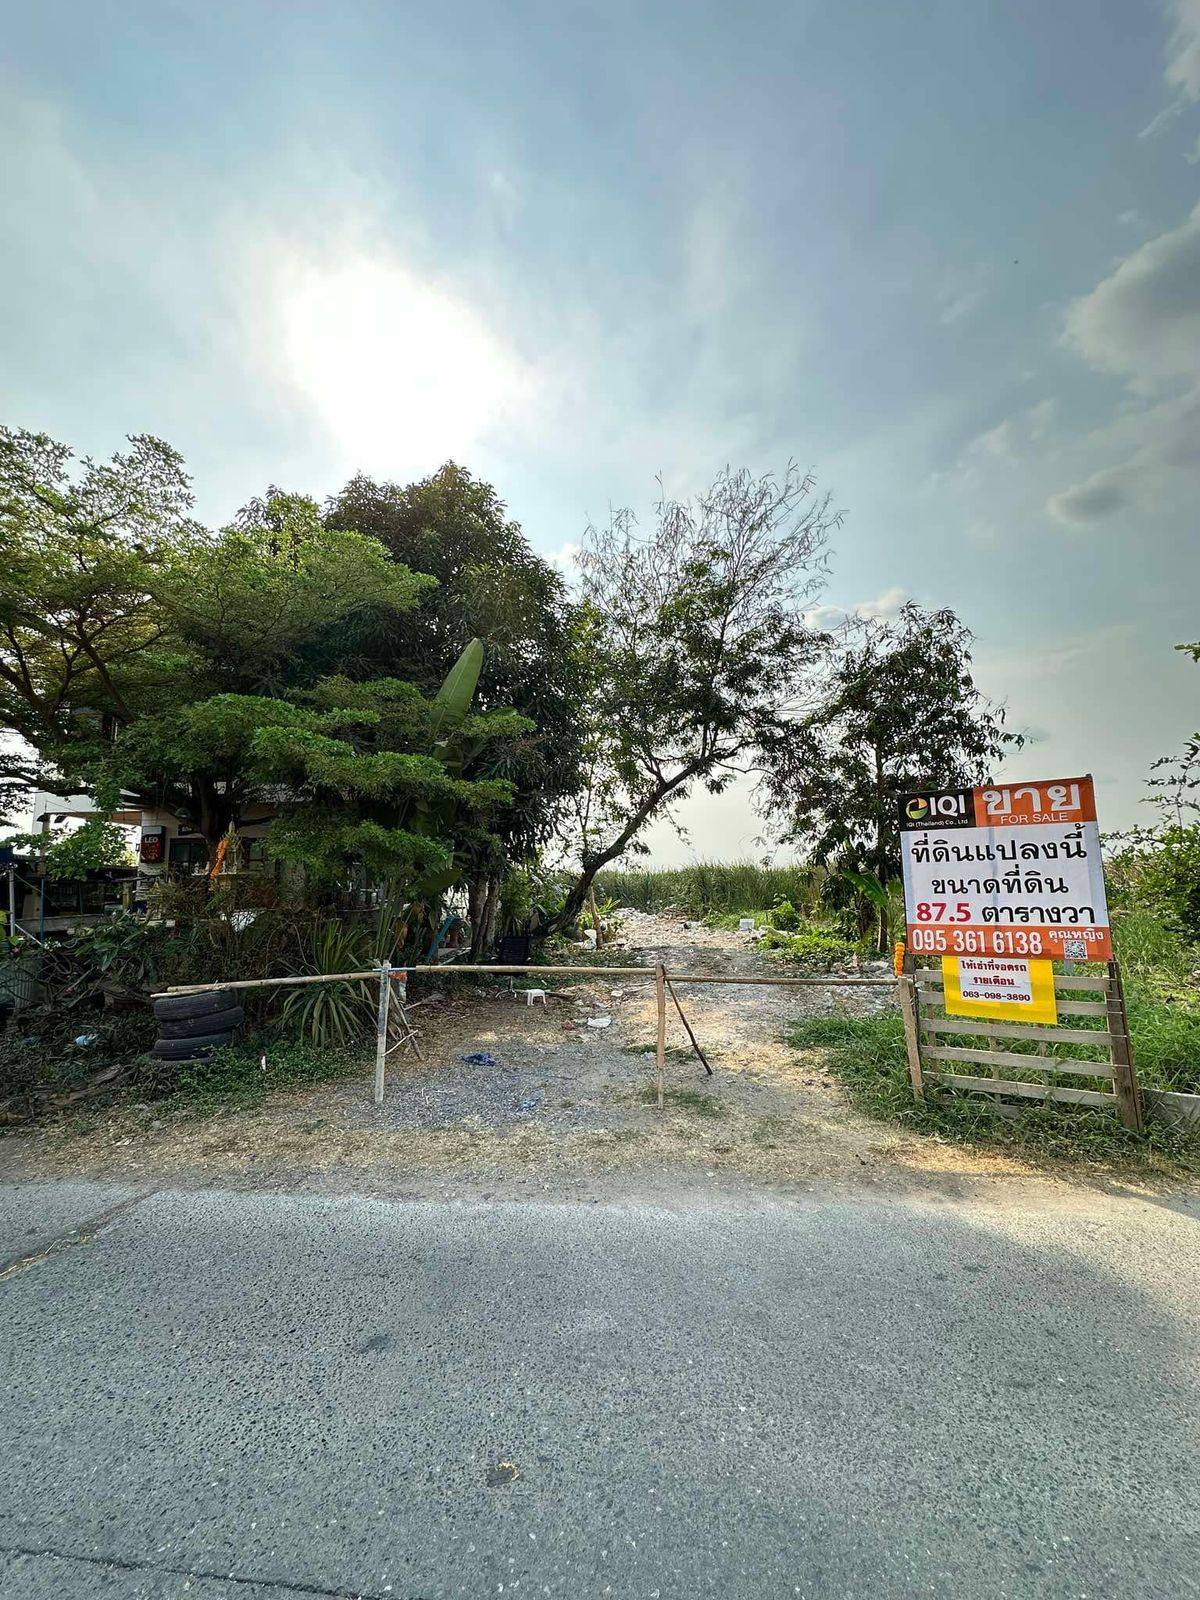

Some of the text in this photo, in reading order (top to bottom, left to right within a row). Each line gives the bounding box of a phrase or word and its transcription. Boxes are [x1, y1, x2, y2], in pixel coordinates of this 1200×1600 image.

[929, 794, 966, 817] IQI
[982, 783, 1081, 816] ขาย
[915, 820, 945, 828] (Thailand)
[1000, 811, 1069, 825] FOR SALE
[144, 836, 159, 844] LEO
[911, 823, 1087, 863] ที่ดินแปลงนี้
[931, 864, 1069, 894] ขนาดที่ดิน
[916, 902, 1096, 924] 87.5 ตารางวา
[912, 928, 1043, 955] 095 361 6138
[1048, 928, 1104, 944] คุณหญิง
[973, 975, 1015, 986] รายเดือน
[962, 990, 1031, 1002] 063-098-3890
